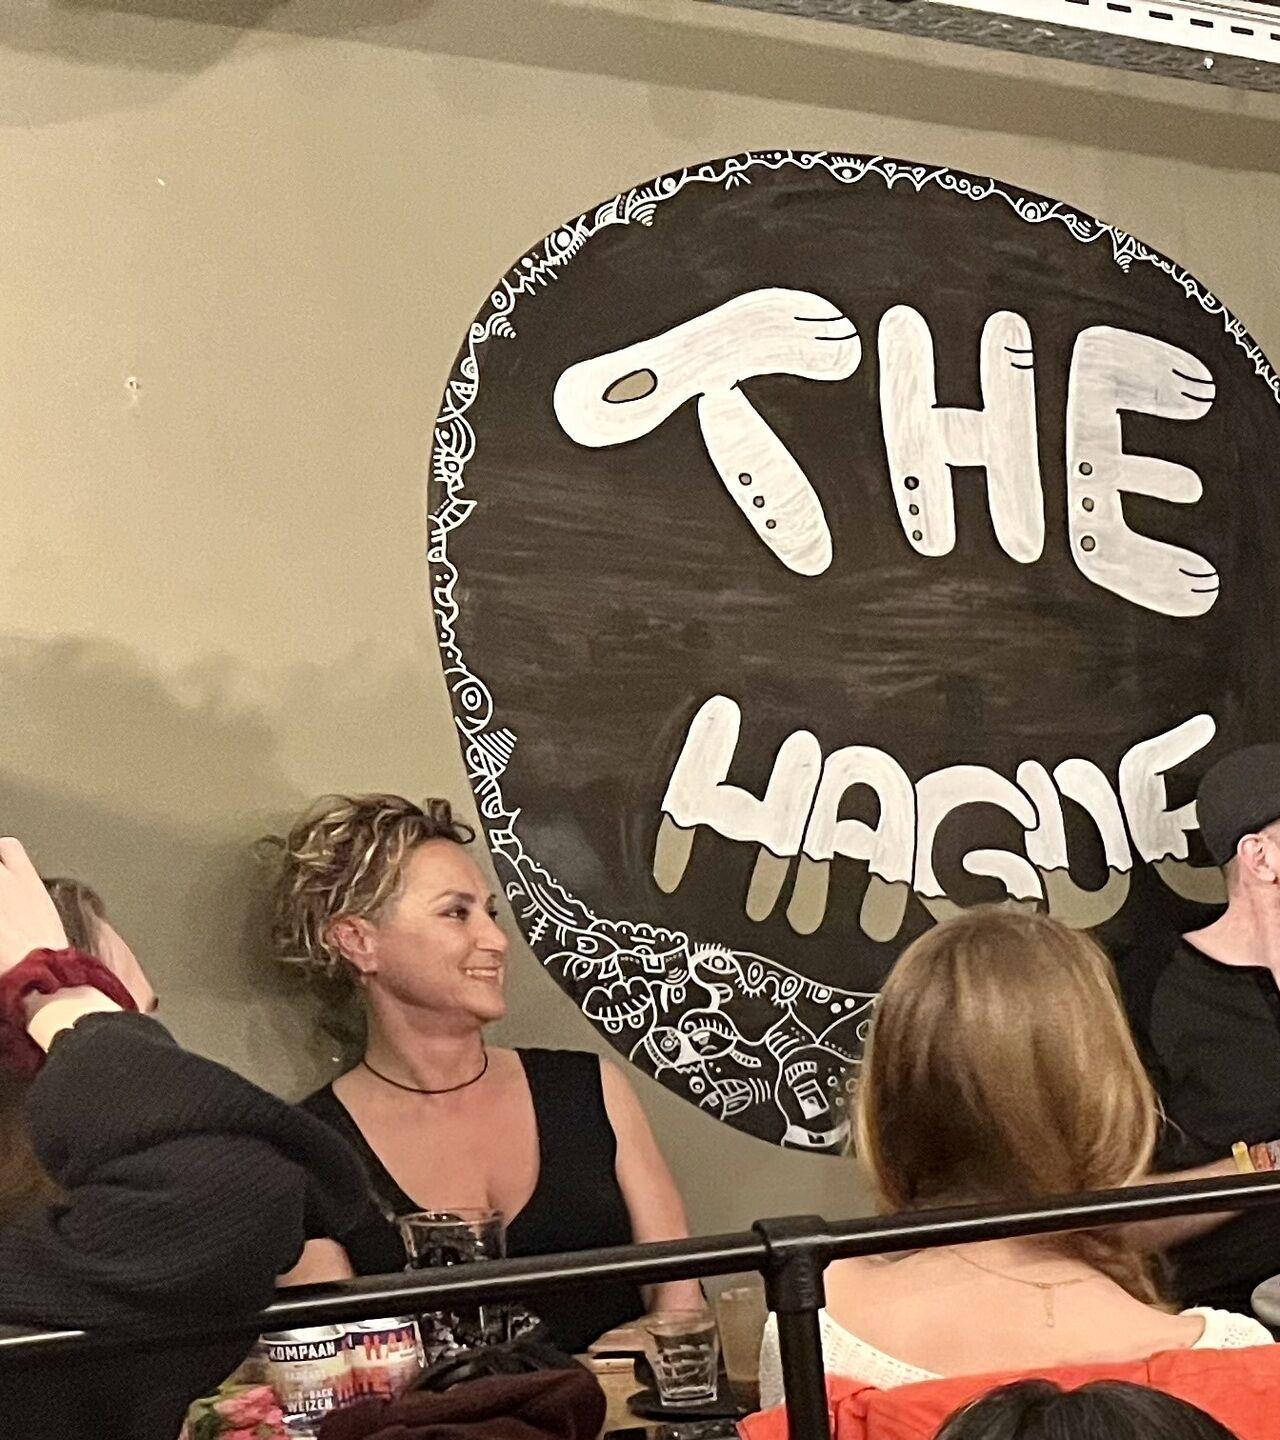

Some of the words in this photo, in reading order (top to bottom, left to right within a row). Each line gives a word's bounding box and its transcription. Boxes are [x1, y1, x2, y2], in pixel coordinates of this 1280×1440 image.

[552, 286, 1221, 618] THE
[652, 692, 1222, 946] HAGUE
[268, 1340, 336, 1361] KOMPAAN
[287, 1397, 334, 1413] WEIZEN
